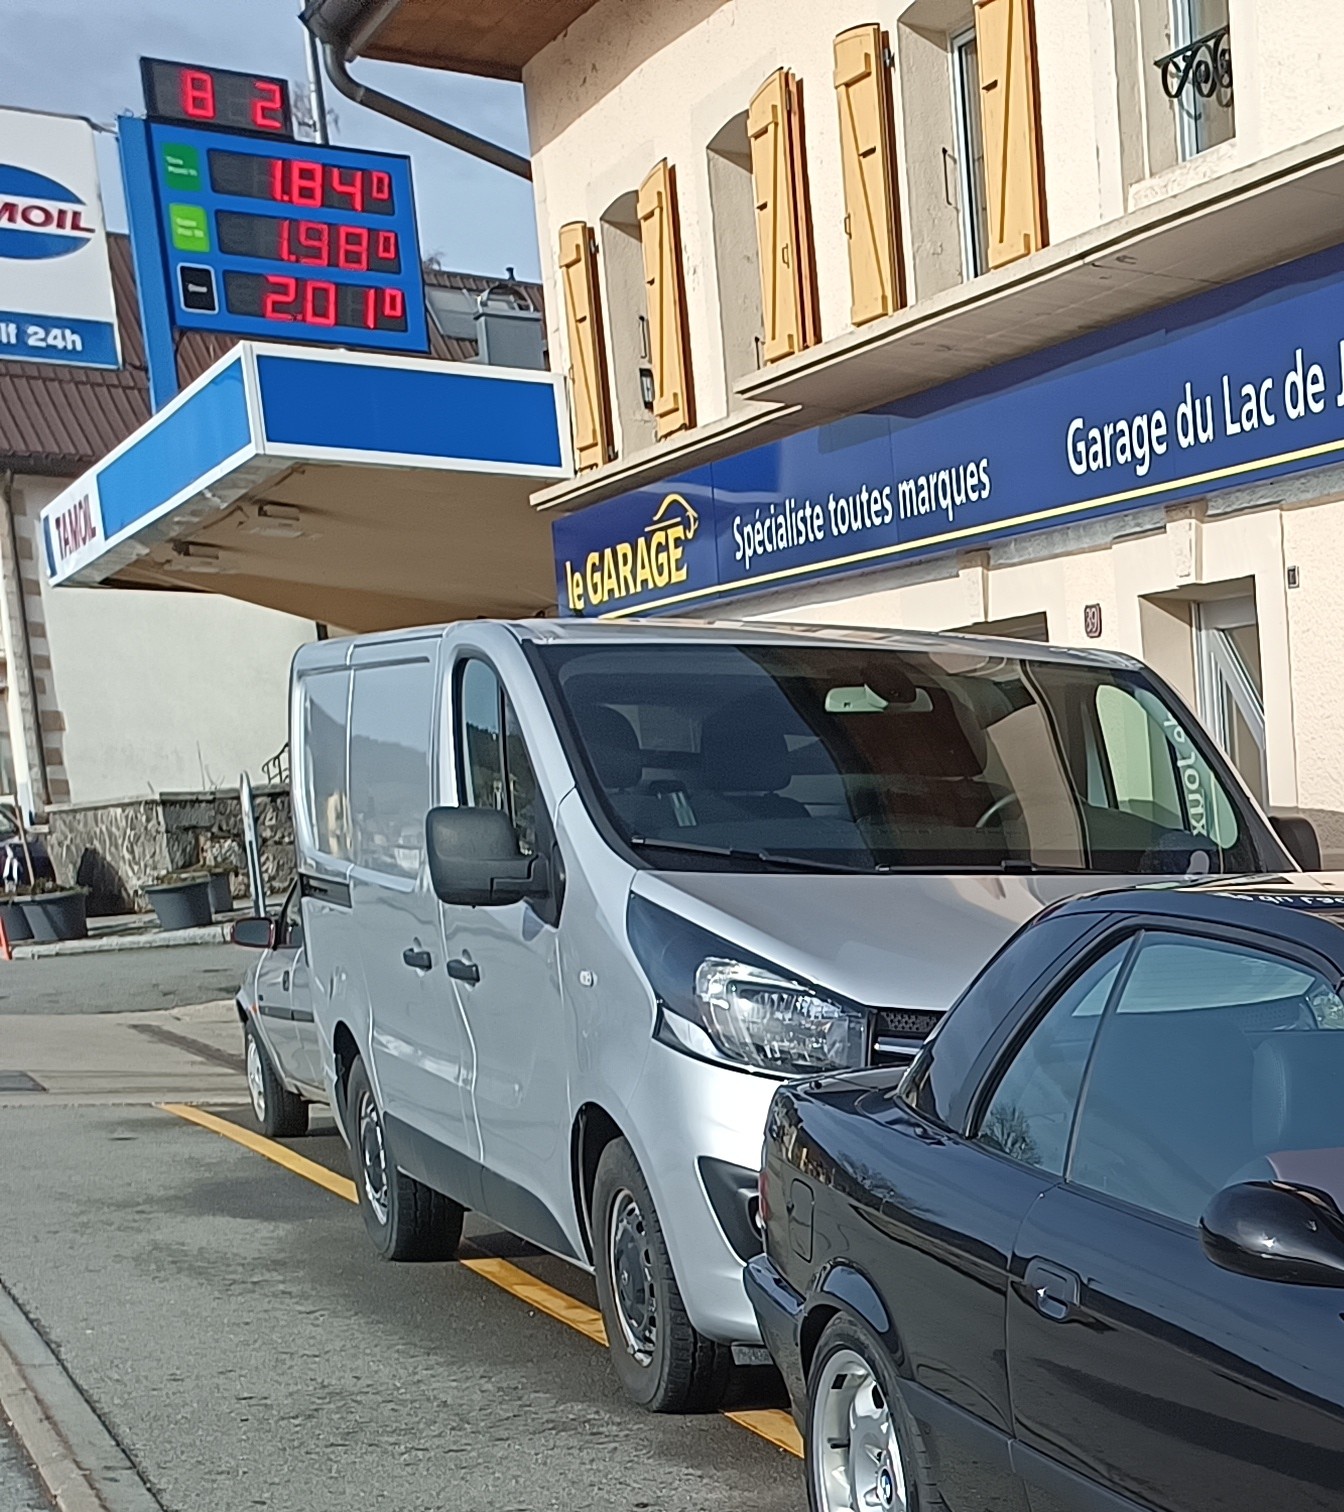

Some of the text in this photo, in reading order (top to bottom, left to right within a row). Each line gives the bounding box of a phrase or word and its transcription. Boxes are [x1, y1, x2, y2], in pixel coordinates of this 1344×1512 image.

[0, 323, 83, 351] lf 24h
[1067, 409, 1167, 477] Garage
[1176, 382, 1214, 448] du
[1223, 375, 1275, 436] Lac
[1284, 348, 1325, 420] de
[733, 457, 992, 570] Spécialiste toutes marques
[565, 525, 687, 610] le GARAGE
